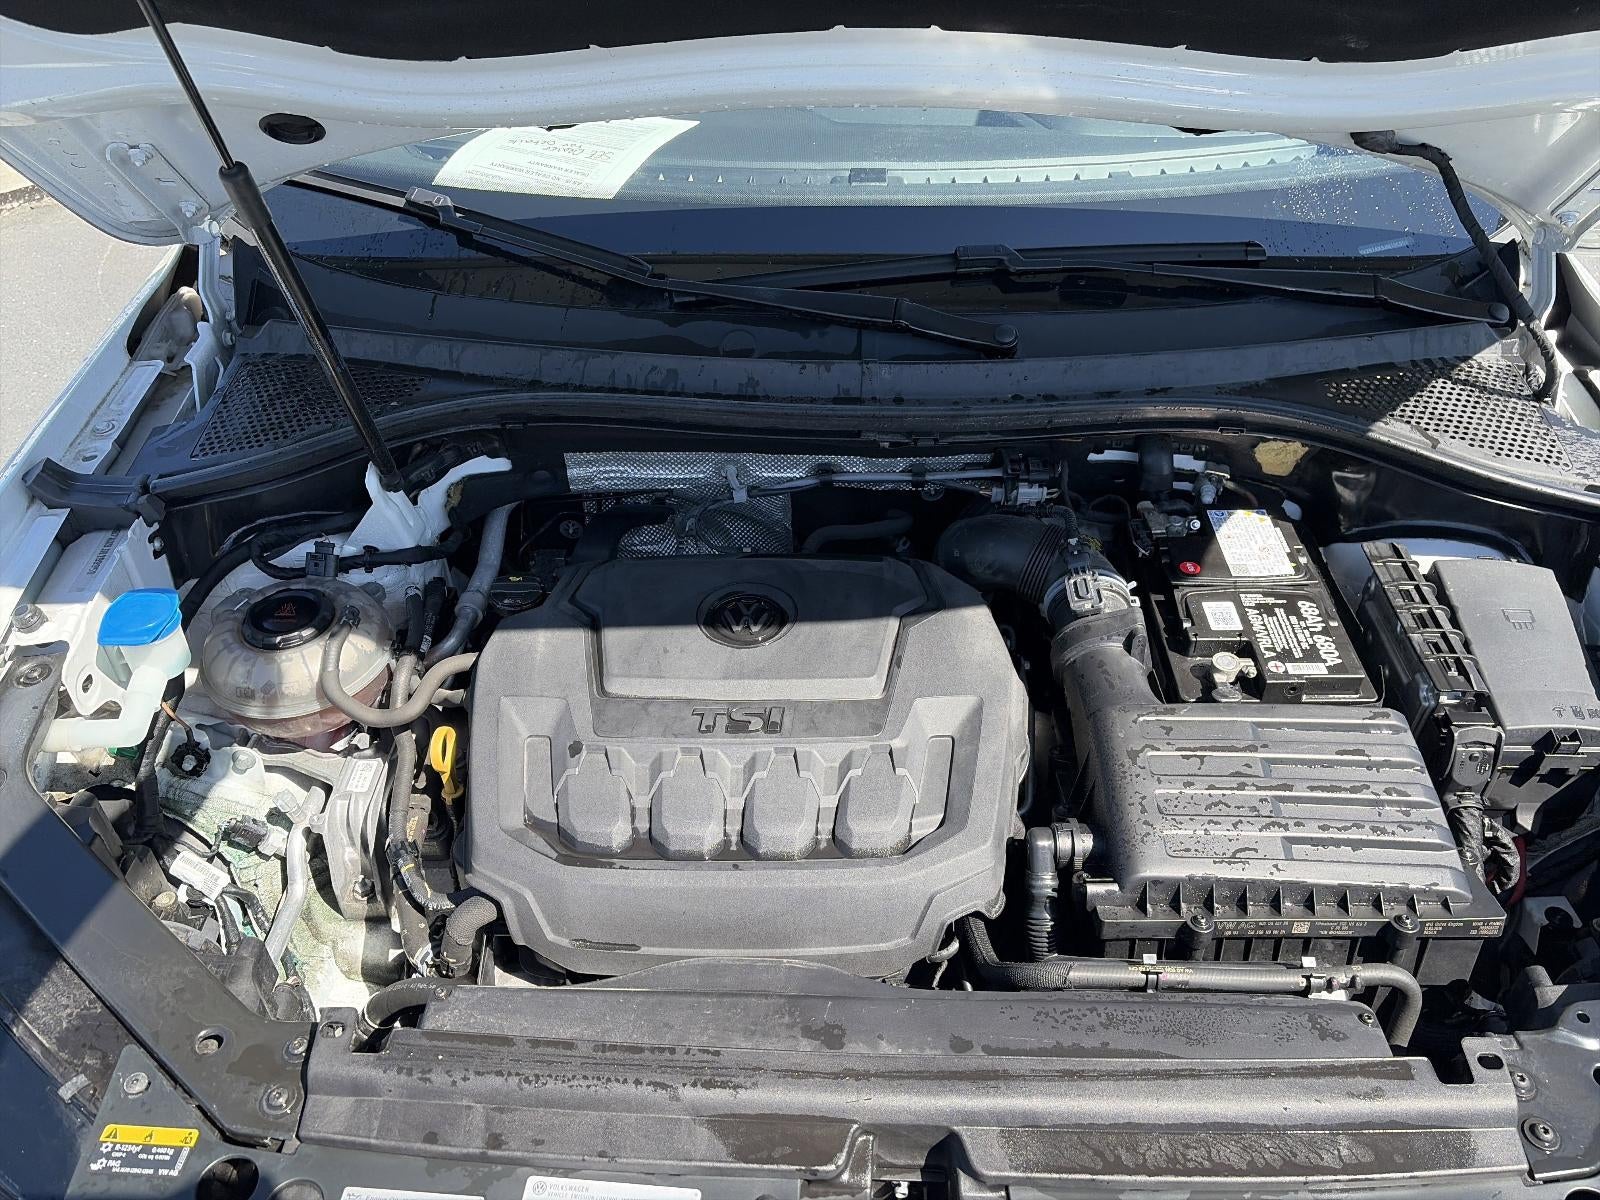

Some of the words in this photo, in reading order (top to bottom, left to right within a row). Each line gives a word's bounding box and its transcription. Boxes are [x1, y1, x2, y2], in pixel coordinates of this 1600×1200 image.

[1297, 600, 1325, 632] 68Ah
[1312, 634, 1342, 666] 680A
[691, 706, 785, 734] TSI
[548, 1183, 590, 1192] VOLKSWAGEN
